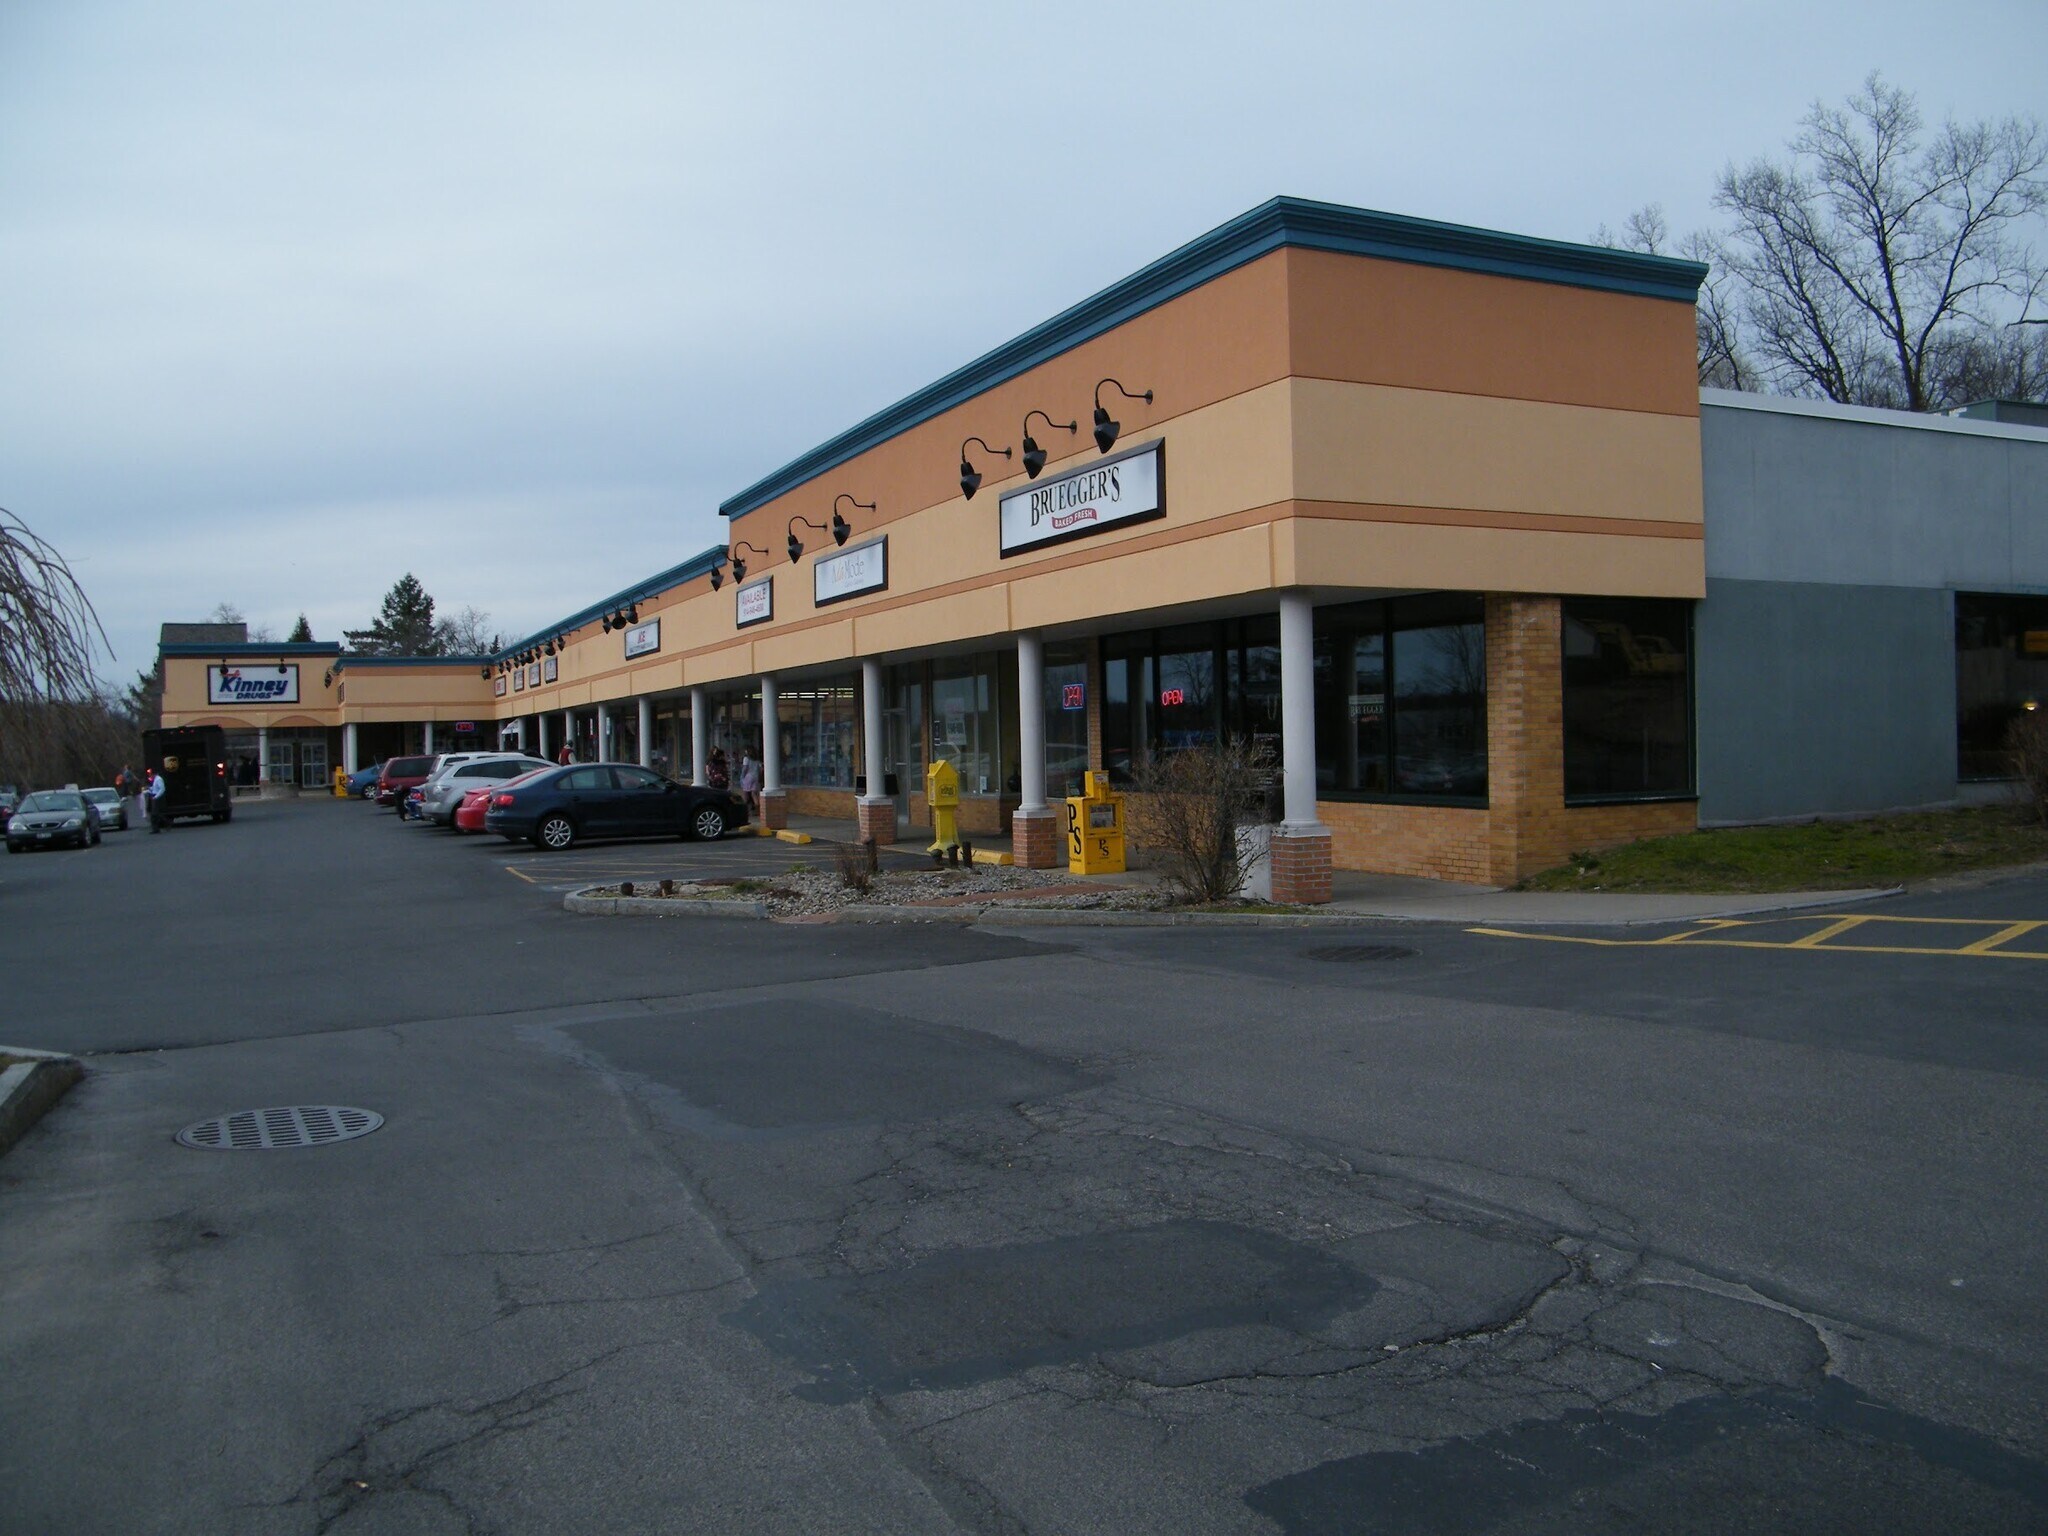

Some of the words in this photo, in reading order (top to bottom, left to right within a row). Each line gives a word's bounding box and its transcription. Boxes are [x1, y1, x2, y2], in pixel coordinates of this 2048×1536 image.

[1030, 466, 1120, 527] BRUEGGER'S
[1054, 516, 1073, 528] BAKED
[1074, 510, 1092, 522] FRESH
[220, 677, 288, 695] Kinney
[236, 692, 272, 700] DRUGS
[1064, 686, 1082, 706] OPEN
[1161, 689, 1183, 706] OPEN
